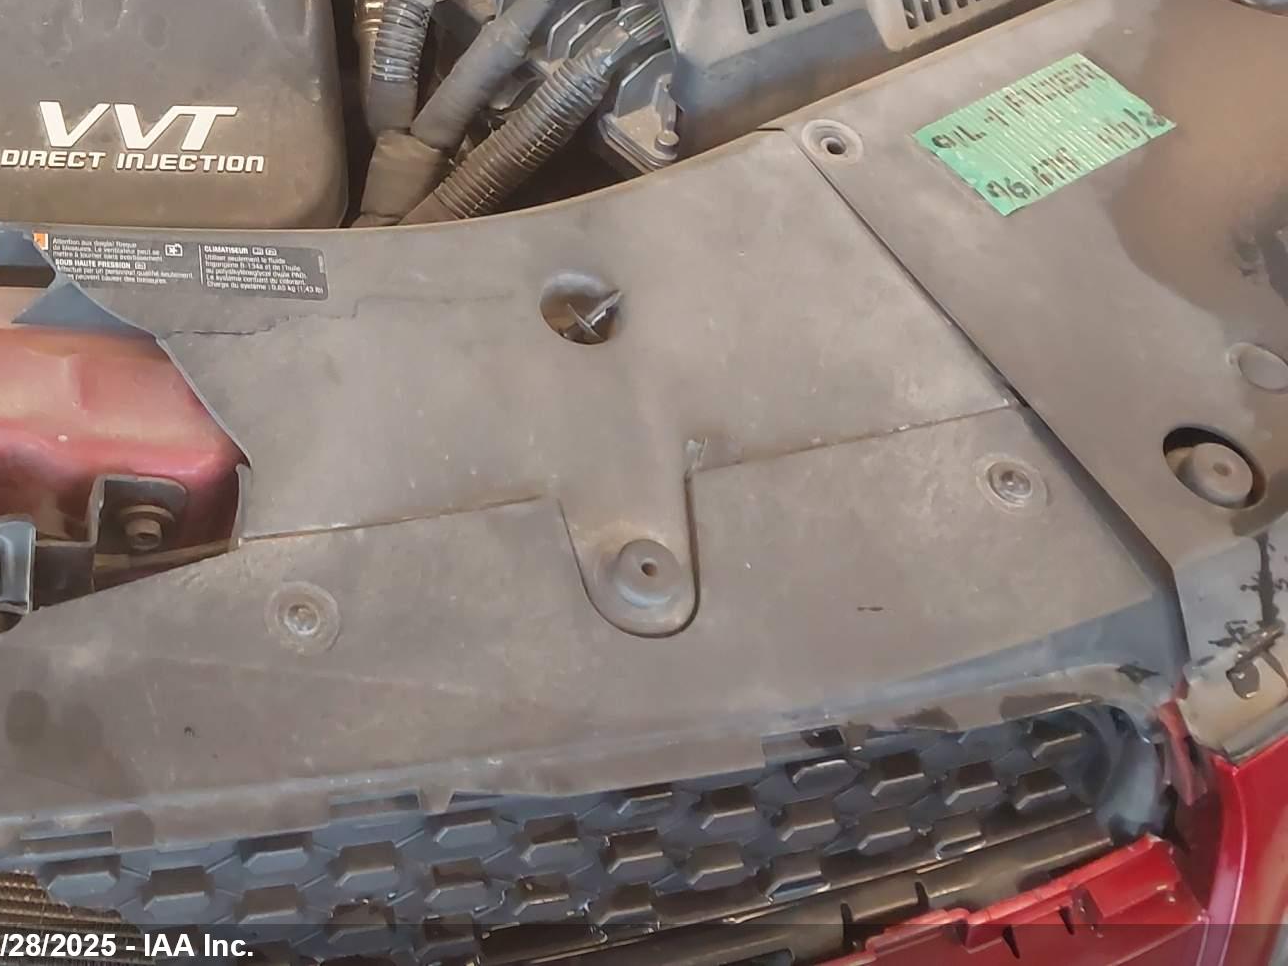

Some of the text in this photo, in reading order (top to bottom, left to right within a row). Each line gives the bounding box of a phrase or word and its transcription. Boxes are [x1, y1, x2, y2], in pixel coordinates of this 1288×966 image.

[38, 100, 238, 151] VVT
[0, 148, 265, 173] DIRECT INJECTION
[204, 245, 249, 254] CLIMATISEUR
[75, 259, 96, 267] HAUTE
[98, 261, 130, 269] PRESSION
[288, 285, 296, 293] kg
